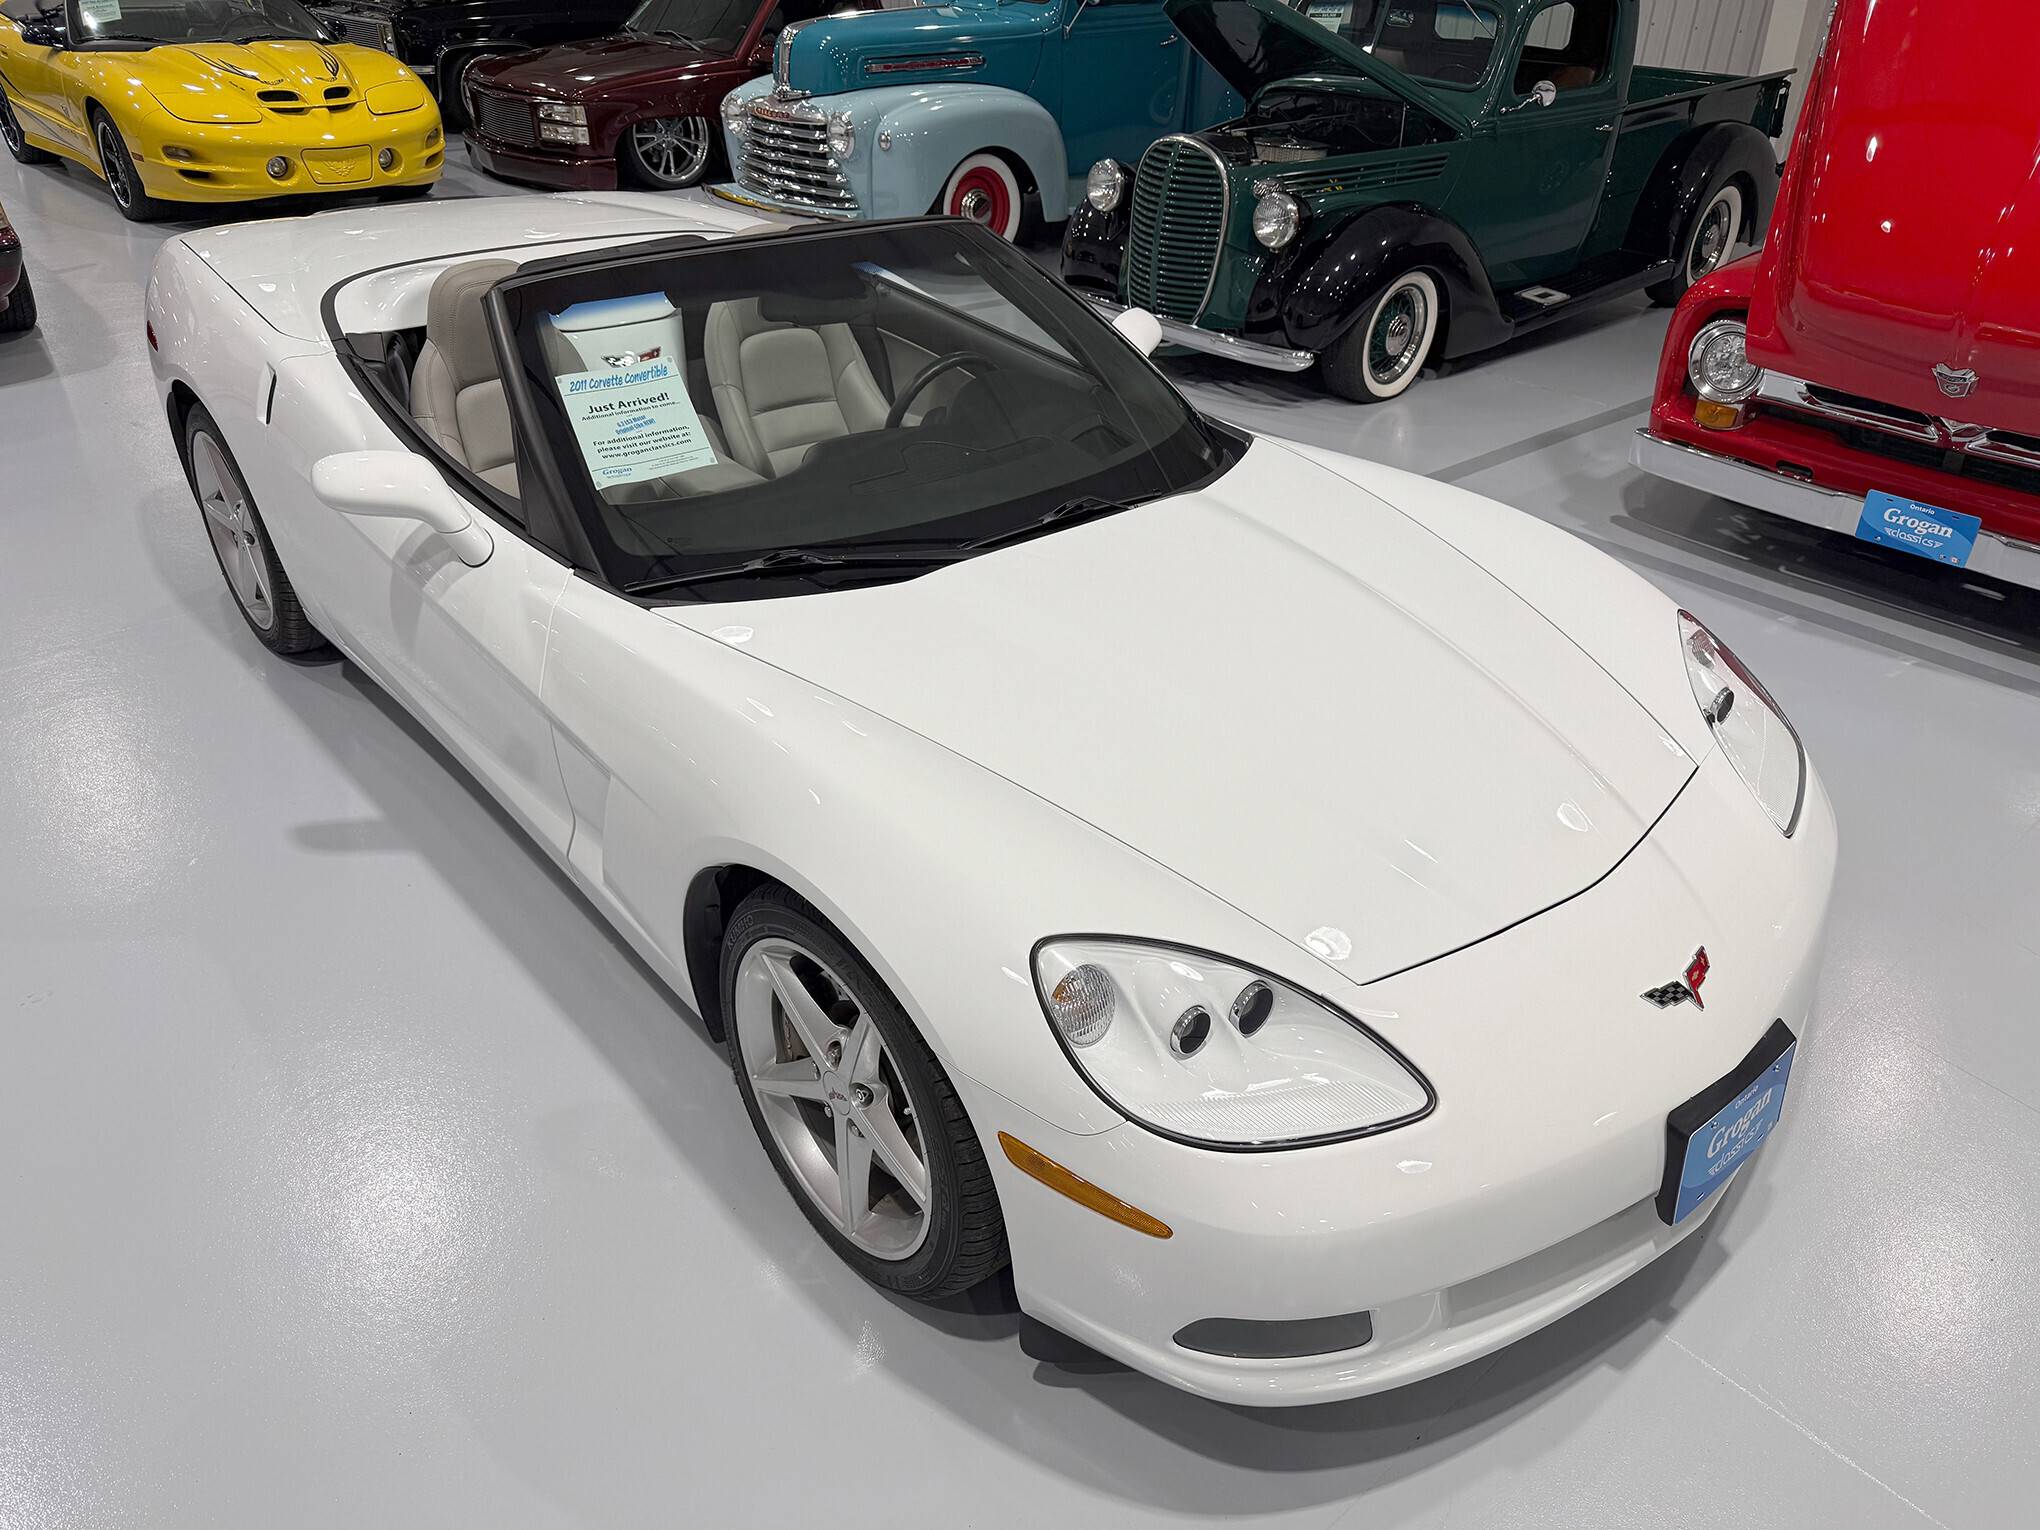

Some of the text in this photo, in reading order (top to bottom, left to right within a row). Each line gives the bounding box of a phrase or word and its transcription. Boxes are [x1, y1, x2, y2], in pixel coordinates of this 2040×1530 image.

[570, 364, 668, 392] 2011 Corvette Convertible
[582, 411, 614, 421] Additional
[615, 406, 651, 416] information
[588, 392, 670, 414] Just Arrived!
[597, 445, 621, 454] please
[622, 442, 638, 450] visit
[652, 434, 681, 444] website
[607, 433, 644, 445] additional
[645, 425, 690, 437] information,
[602, 438, 692, 459] www.groganclassics.com
[602, 467, 632, 475] Grogan
[1909, 504, 1935, 515] Ontario
[1883, 507, 1953, 538] Grogan
[1891, 528, 1935, 547] classics
[1735, 1085, 1759, 1109] Ontario
[1707, 1087, 1772, 1158] Grogan
[1715, 1126, 1757, 1172] classics
